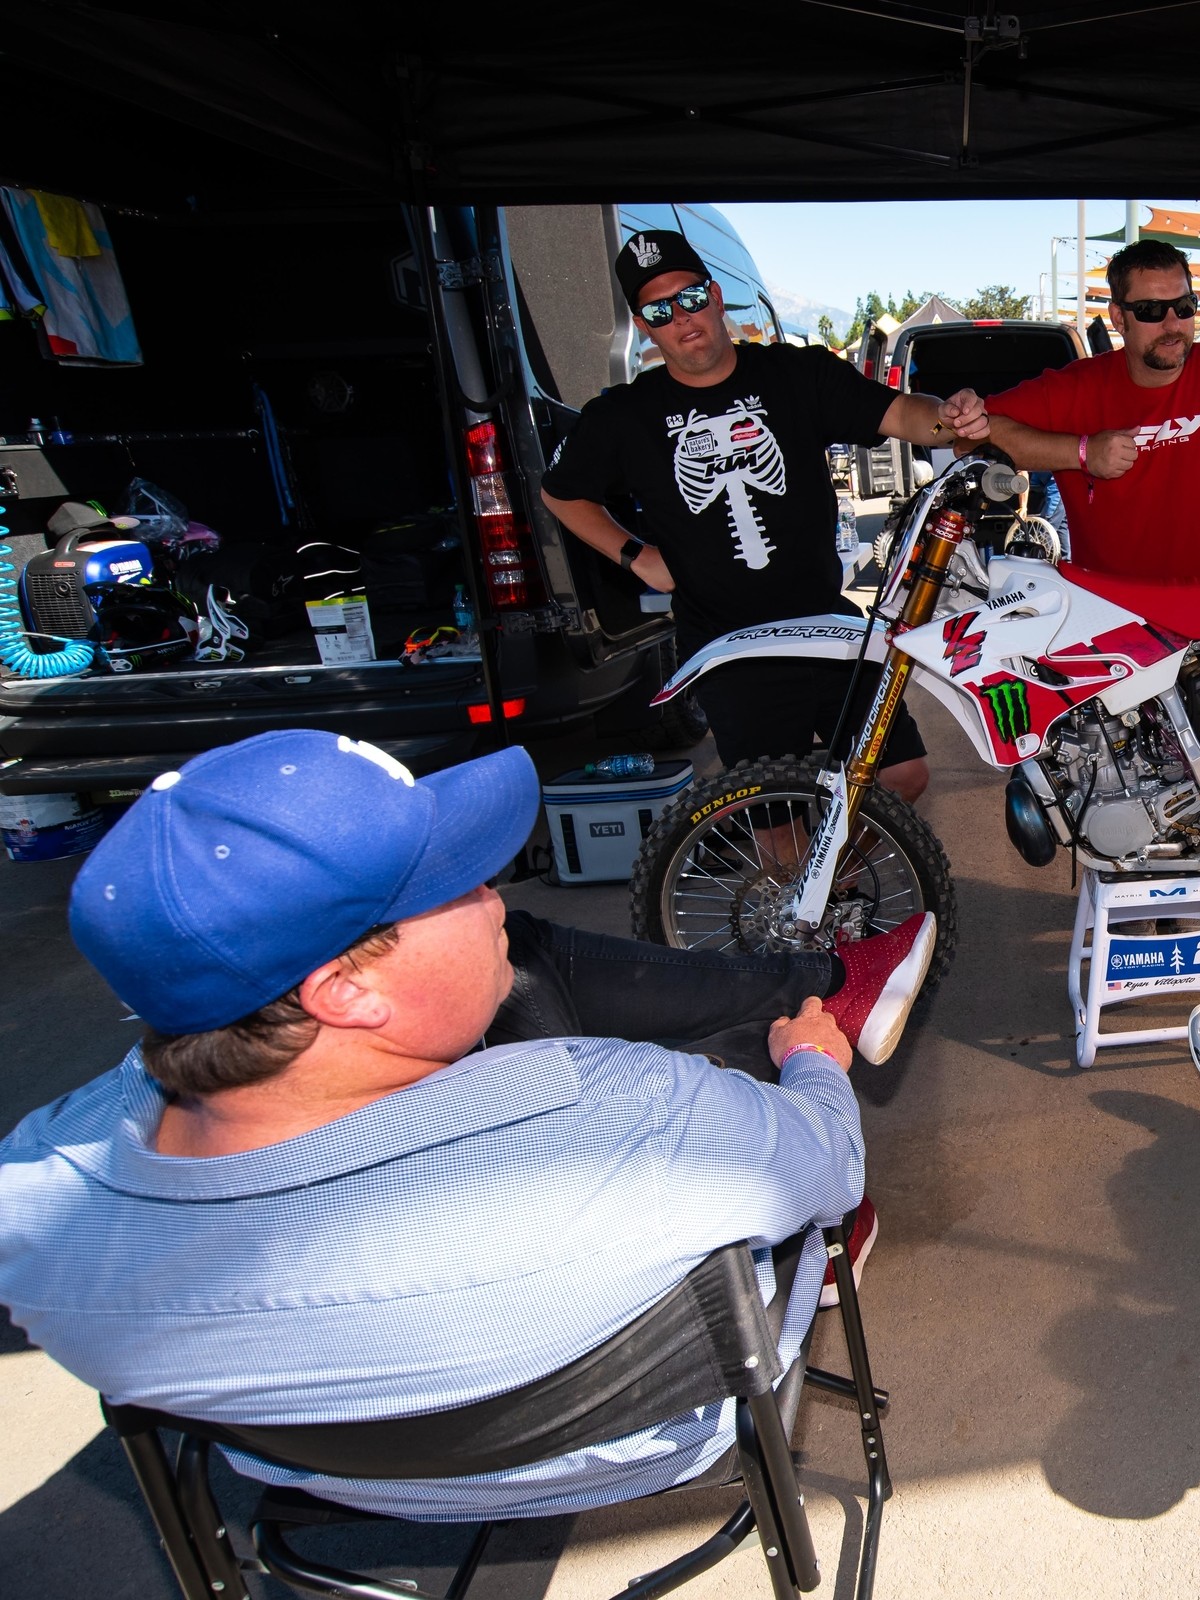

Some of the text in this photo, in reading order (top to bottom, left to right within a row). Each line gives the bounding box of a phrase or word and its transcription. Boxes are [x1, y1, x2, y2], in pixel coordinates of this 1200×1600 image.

[1135, 436, 1190, 452] ACING
[705, 452, 758, 477] KTM
[984, 590, 1027, 611] YAMAHA
[726, 625, 866, 643] PRO CIRCUIT
[855, 721, 872, 759] PRO
[868, 659, 895, 725] CIRCUIT
[879, 670, 906, 730] SHOWA
[690, 785, 762, 824] DUNLOP
[592, 824, 623, 835] YETI
[814, 834, 834, 870] YAMAHA
[1122, 951, 1165, 966] YAMAHA
[1123, 981, 1149, 992] Ryan
